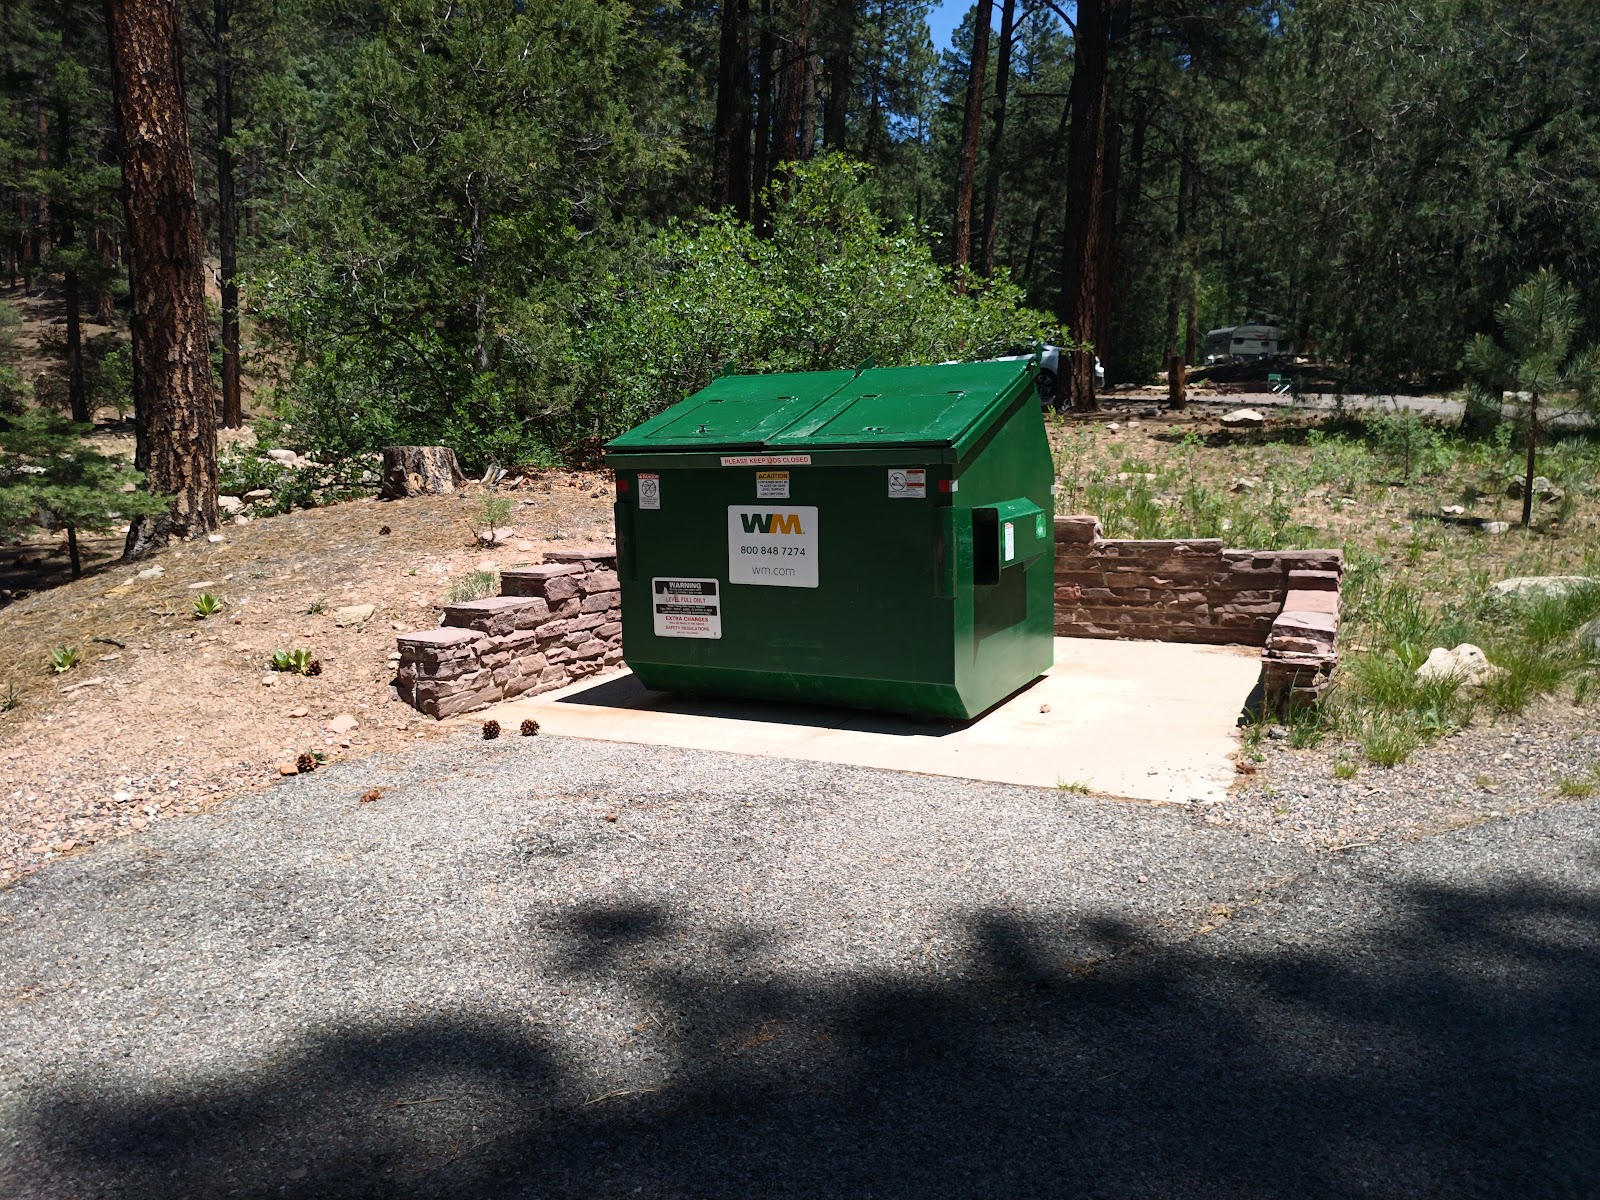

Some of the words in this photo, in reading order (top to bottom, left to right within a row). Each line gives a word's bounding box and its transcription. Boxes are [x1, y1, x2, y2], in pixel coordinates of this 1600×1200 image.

[740, 513, 803, 535] WM
[740, 545, 759, 555] 800
[760, 546, 779, 556] 848
[781, 547, 806, 556] 7274
[751, 566, 796, 577] wm.com
